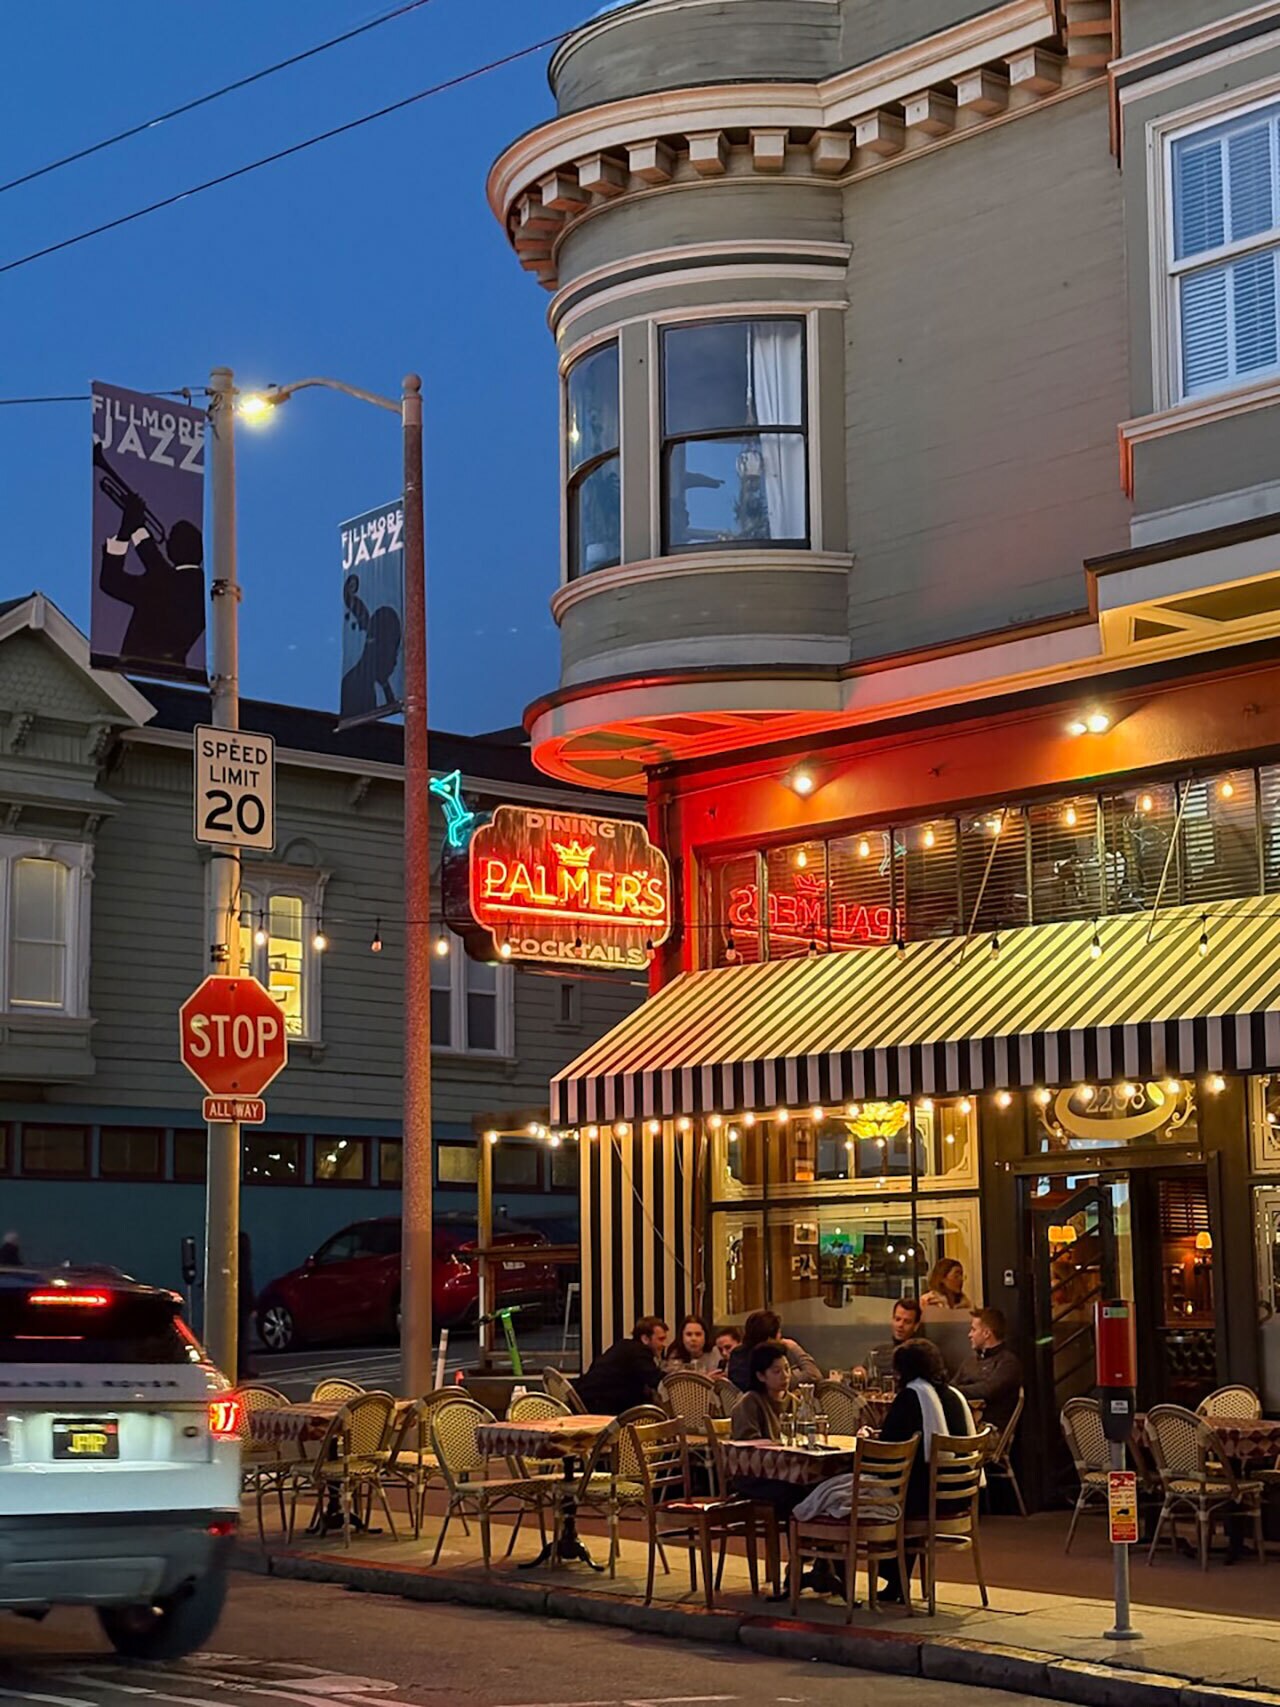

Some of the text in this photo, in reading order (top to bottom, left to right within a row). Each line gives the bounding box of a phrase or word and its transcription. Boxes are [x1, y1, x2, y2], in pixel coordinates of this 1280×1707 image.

[93, 394, 204, 440] FILLMORE
[93, 415, 204, 474] JAZZ
[341, 509, 404, 548] FILLMORE
[342, 521, 404, 570] JAZZ
[202, 740, 268, 765] SPEED
[210, 764, 260, 788] LIMIT
[204, 789, 265, 835] 20
[526, 813, 616, 839] DINING
[480, 857, 666, 917] PALMER'S
[507, 937, 643, 964] COCKTAILS
[189, 1013, 278, 1059] STOP
[209, 1102, 260, 1118] ALL WAY
